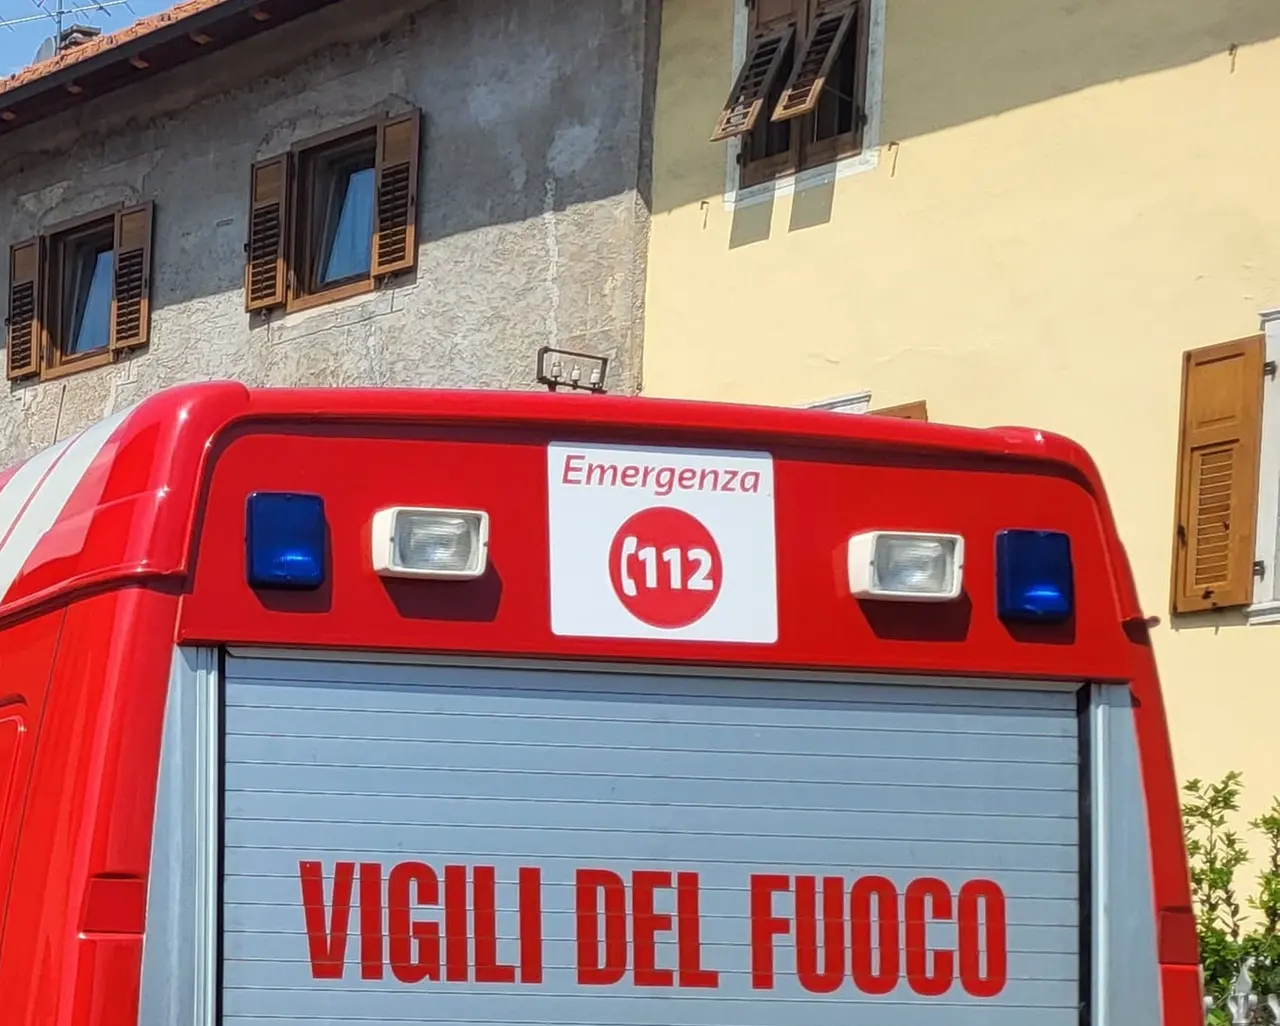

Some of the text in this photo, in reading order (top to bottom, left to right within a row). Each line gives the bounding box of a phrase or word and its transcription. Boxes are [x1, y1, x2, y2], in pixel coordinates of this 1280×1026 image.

[561, 454, 761, 496] Emergenza
[637, 546, 714, 591] 112
[298, 860, 1007, 998] VIGILI DEL FUOCO
